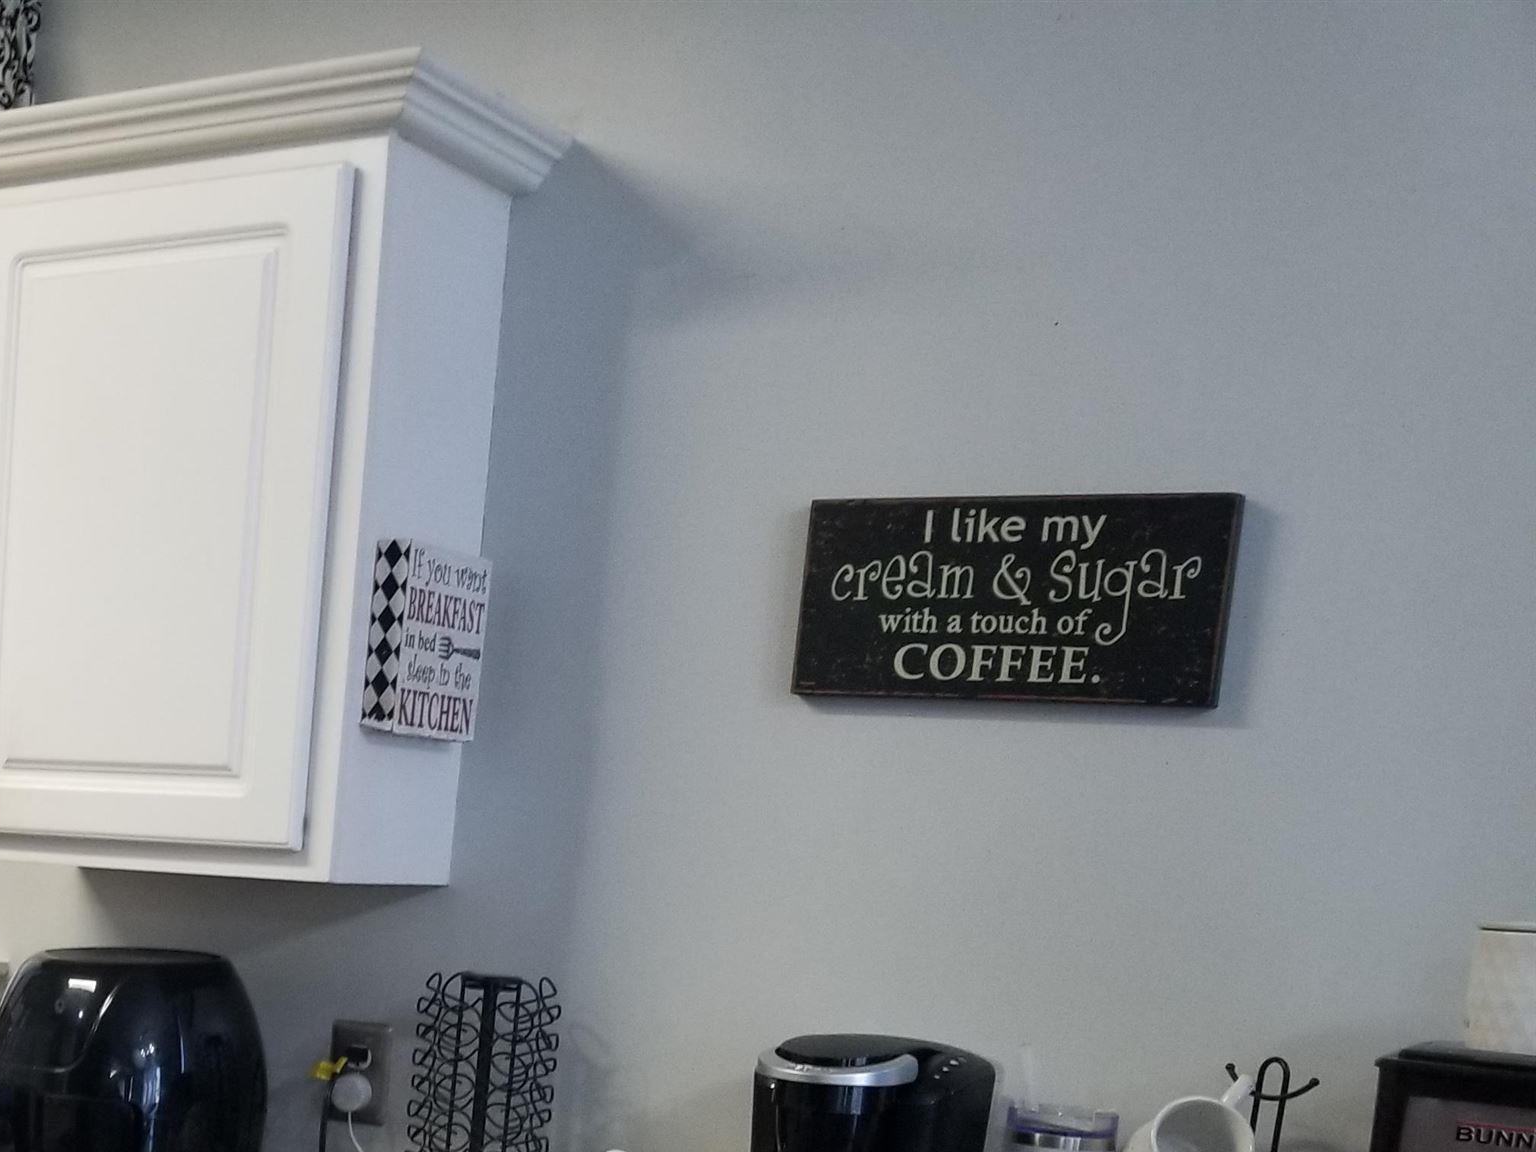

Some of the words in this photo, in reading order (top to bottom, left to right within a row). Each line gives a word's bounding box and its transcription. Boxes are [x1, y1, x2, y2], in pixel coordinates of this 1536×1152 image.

[924, 509, 934, 543] I
[951, 509, 1026, 543] like
[1041, 513, 1107, 550] my
[411, 548, 425, 579] If
[425, 558, 451, 587] you
[455, 567, 488, 594] want
[831, 550, 974, 600] cream
[992, 553, 1031, 606] &
[407, 587, 485, 634] BREAKFAST
[879, 608, 937, 634] with
[947, 615, 963, 634] a
[971, 609, 1047, 635] touch
[1057, 609, 1091, 635] of
[404, 627, 415, 649] in
[418, 630, 437, 652] bed
[454, 662, 471, 691] the
[893, 643, 1100, 684] COFFEE.
[398, 688, 474, 735] KITCHEN
[1456, 1125, 1536, 1149] BUNN
